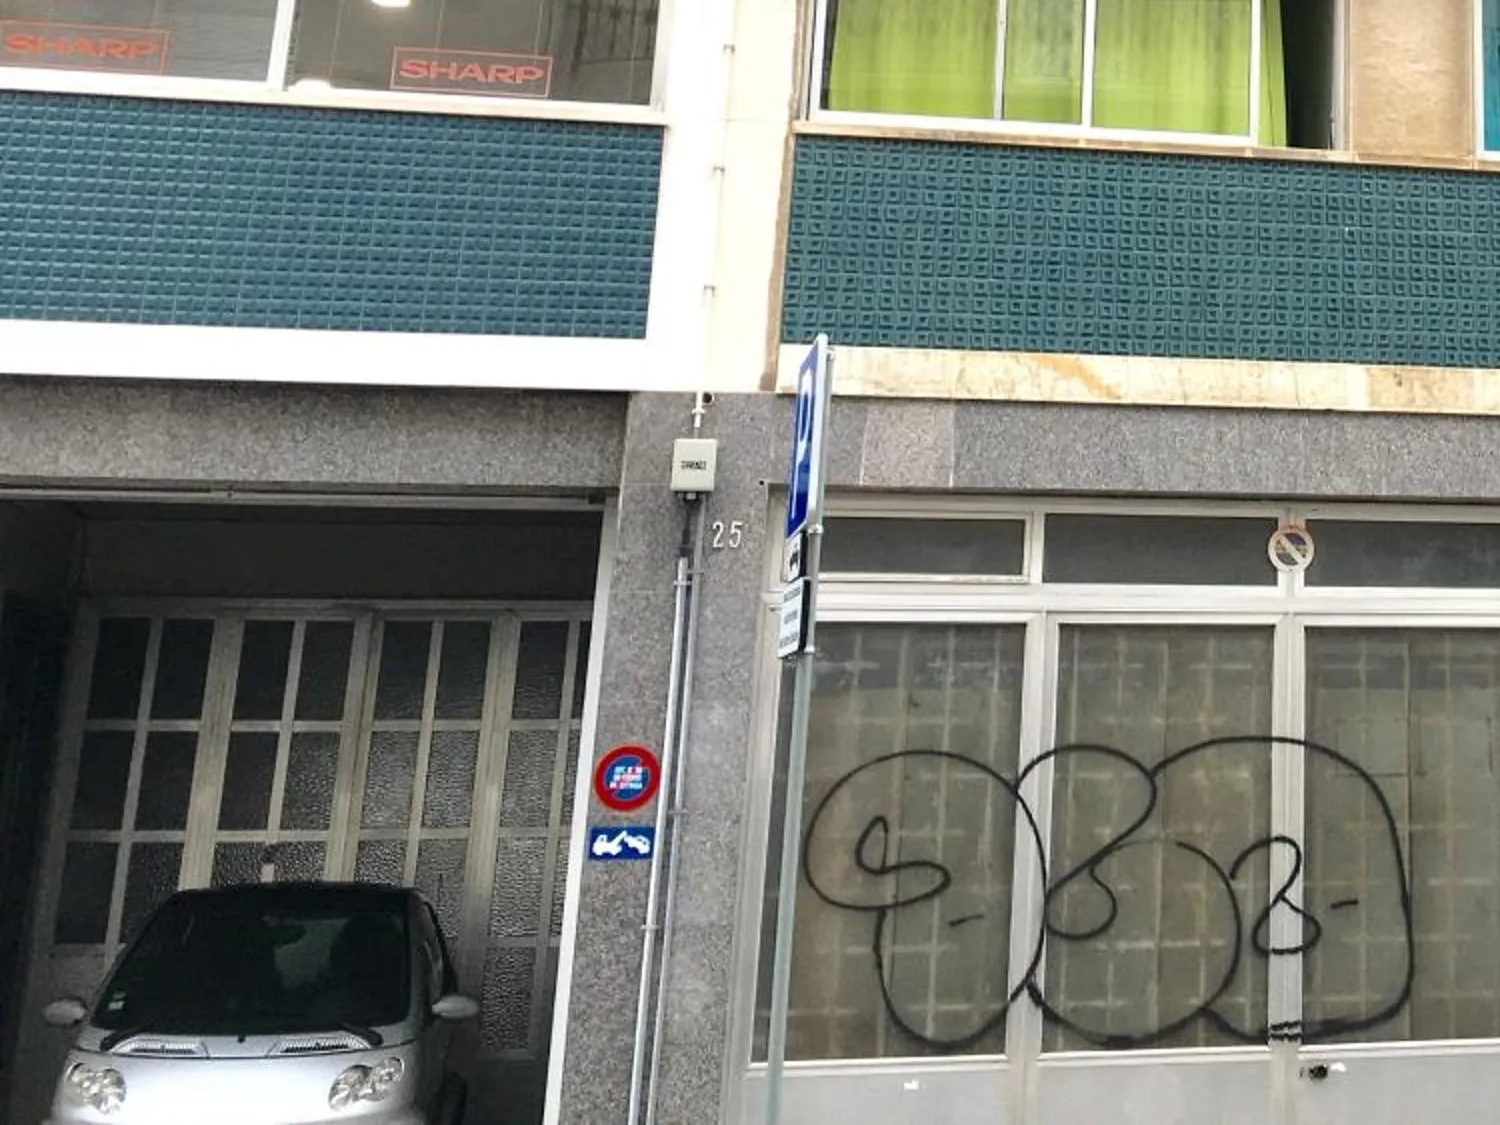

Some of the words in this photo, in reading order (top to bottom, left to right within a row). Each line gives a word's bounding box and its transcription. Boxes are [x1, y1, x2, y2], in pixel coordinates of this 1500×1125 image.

[5, 35, 160, 59] SHARP
[399, 59, 545, 84] SHARP
[712, 520, 743, 548] 25
